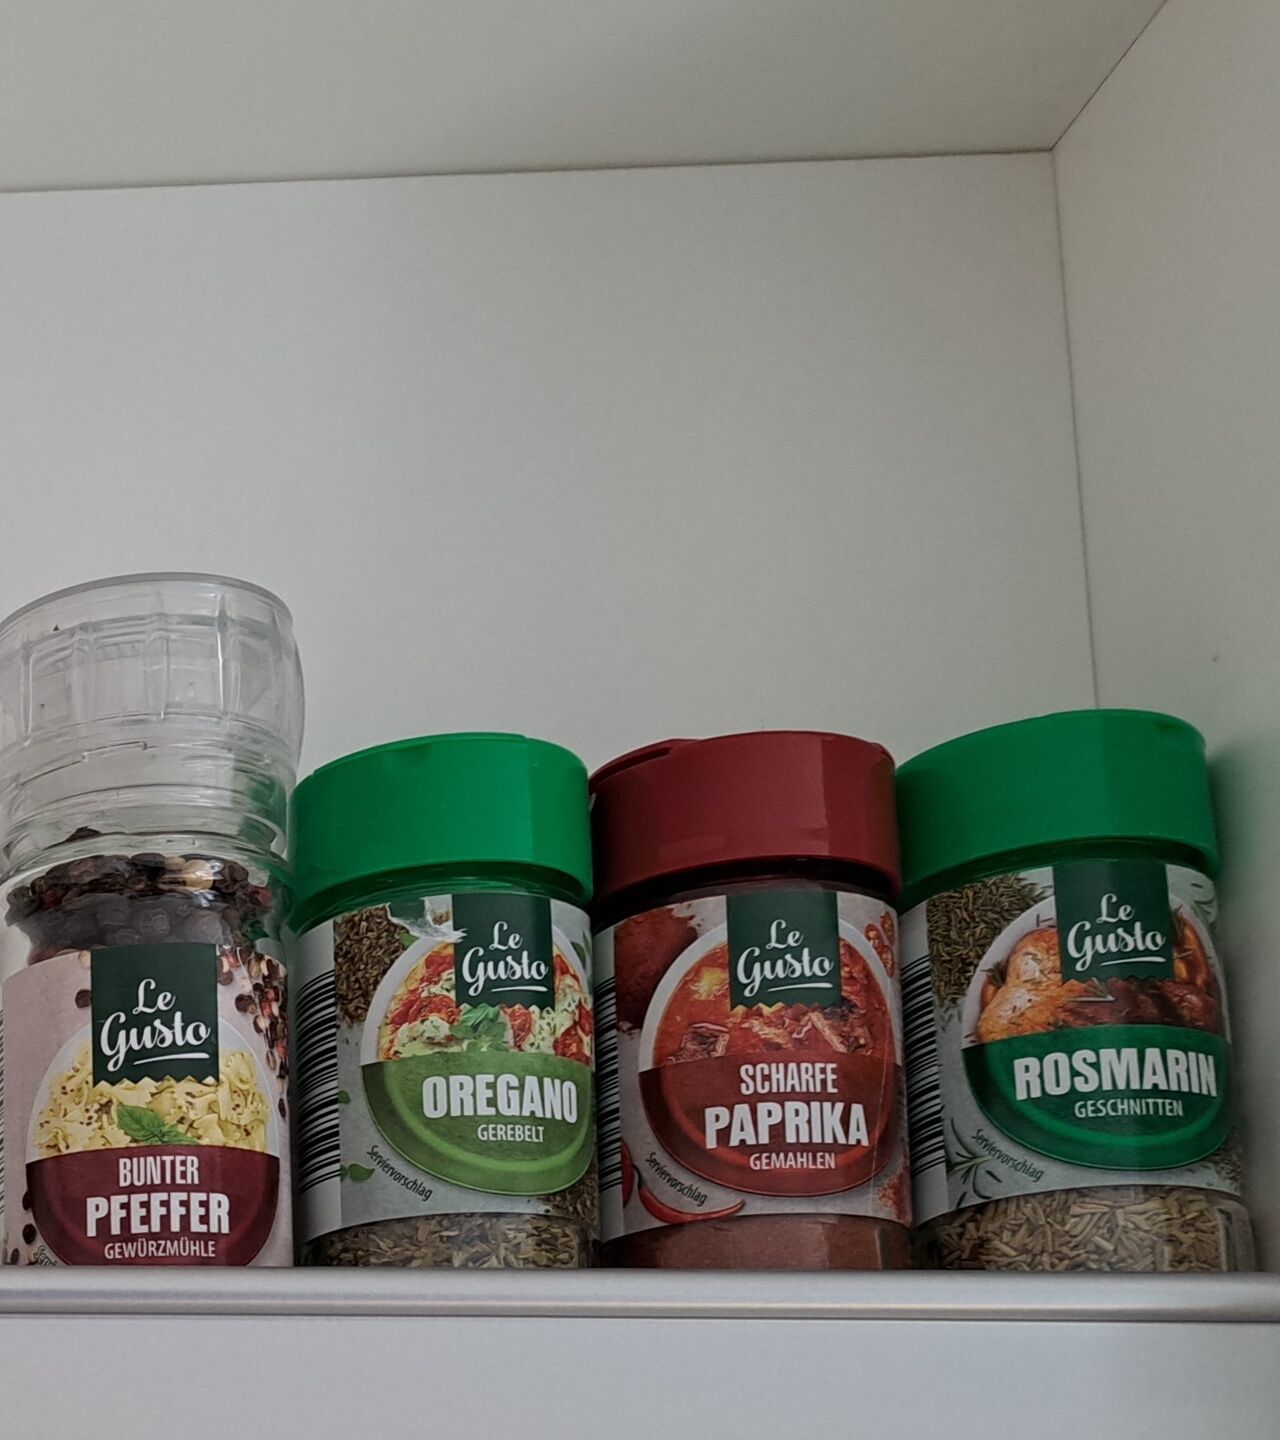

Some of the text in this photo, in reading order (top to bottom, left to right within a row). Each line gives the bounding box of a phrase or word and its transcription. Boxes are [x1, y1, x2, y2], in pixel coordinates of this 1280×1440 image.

[1096, 892, 1135, 925] Le
[489, 920, 523, 951] Le
[765, 919, 803, 950] Le
[1066, 920, 1166, 972] Gusto
[461, 946, 549, 997] Gusto
[736, 946, 834, 997] Gusto
[132, 978, 176, 1015] Le
[100, 1010, 211, 1072] Gusto
[739, 1062, 838, 1096] SCHARFE
[1013, 1047, 1218, 1101] ROSMARIN
[422, 1074, 578, 1123] OREGANO
[1074, 1098, 1184, 1118] GESCHNITTEN
[477, 1123, 545, 1142] GEREBELT
[704, 1101, 869, 1149] PAPRIKA
[118, 1155, 200, 1187] BUNTER
[366, 1144, 434, 1202] Serviervorschlag
[749, 1151, 836, 1170] GEMAHLEN
[86, 1192, 230, 1238] PFEFFER
[104, 1237, 217, 1260] GEWÜRZMÜHLE
